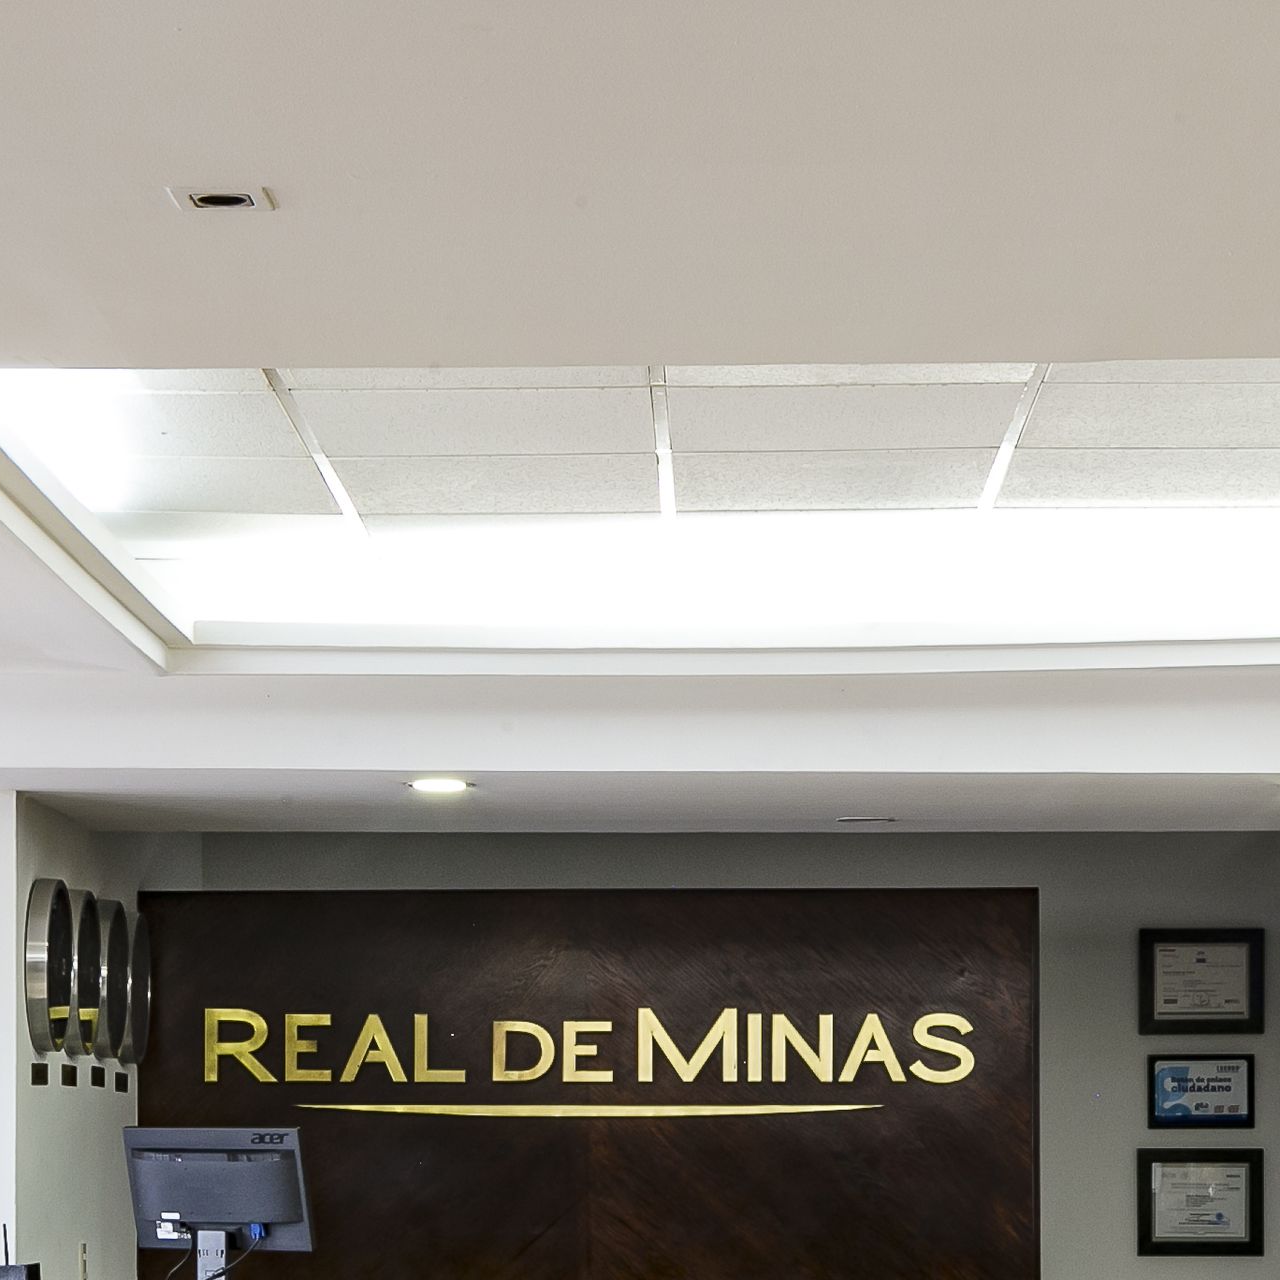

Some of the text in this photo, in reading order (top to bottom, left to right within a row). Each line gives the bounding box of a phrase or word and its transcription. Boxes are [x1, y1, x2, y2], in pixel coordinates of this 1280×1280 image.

[204, 1007, 976, 1084] REAL DE MINAS
[1171, 1084, 1232, 1093] ciudadano
[251, 1133, 289, 1144] acer
